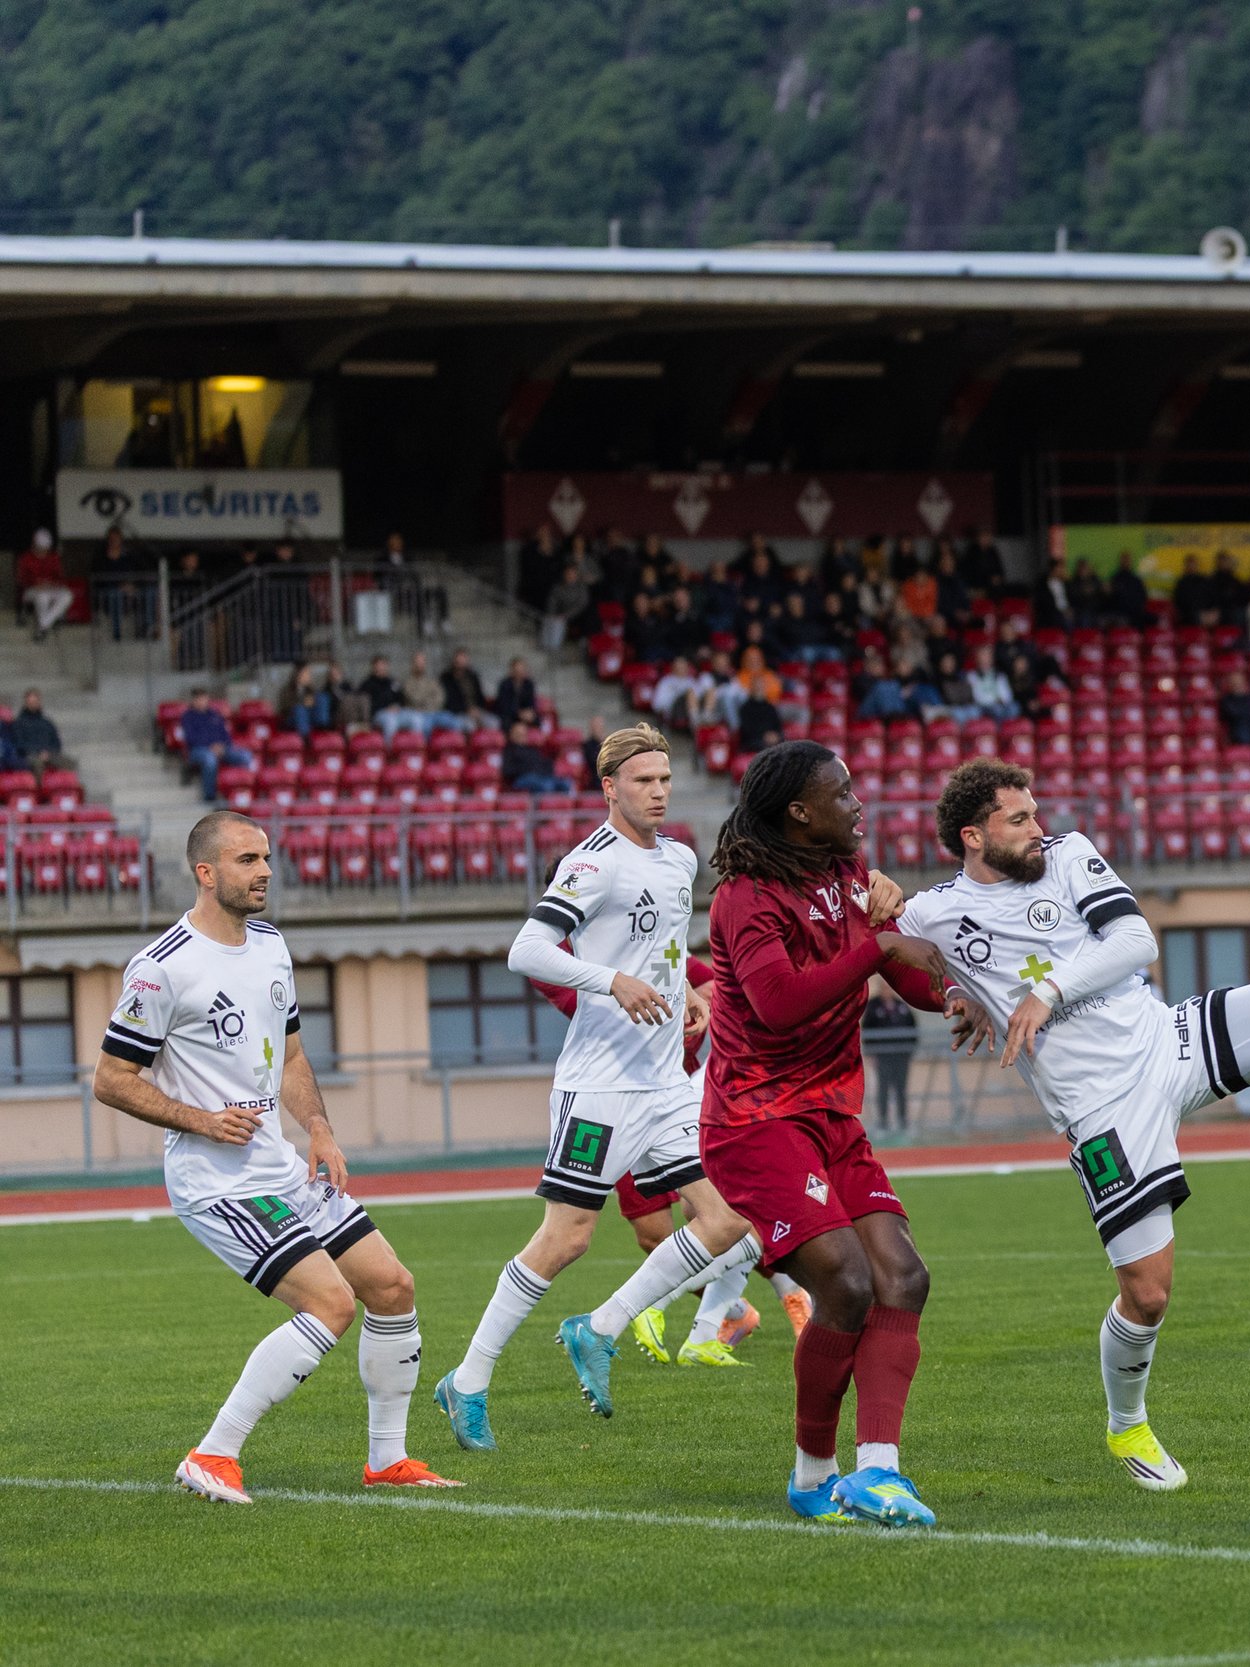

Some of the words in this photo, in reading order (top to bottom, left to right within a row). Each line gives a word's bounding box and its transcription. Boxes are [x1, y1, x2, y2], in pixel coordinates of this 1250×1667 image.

[139, 489, 321, 517] SECURITAS
[629, 931, 656, 942] dieci
[216, 1033, 249, 1049] dieci
[568, 1160, 593, 1172] STORA
[1099, 1180, 1126, 1197] STORA
[277, 1215, 299, 1230] STORA
